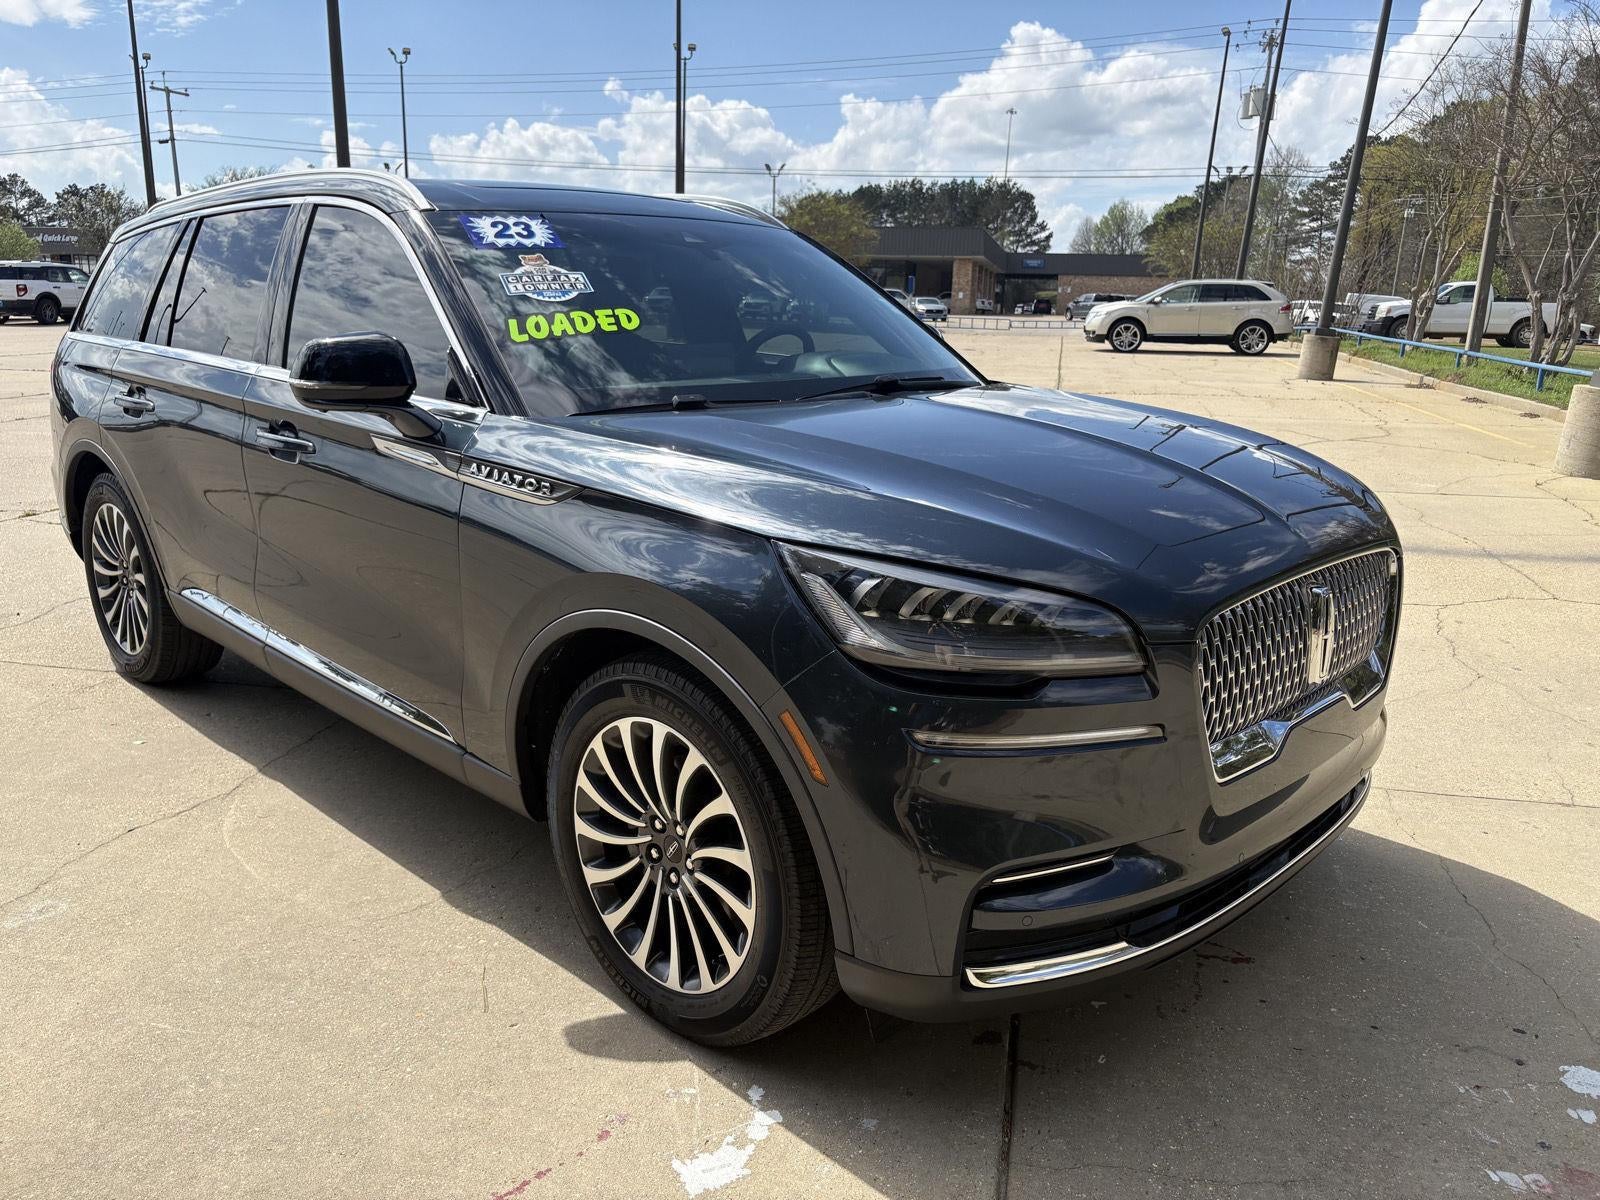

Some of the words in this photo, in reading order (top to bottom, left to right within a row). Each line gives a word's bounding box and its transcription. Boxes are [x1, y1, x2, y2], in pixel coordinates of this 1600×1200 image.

[490, 220, 535, 240] 23
[43, 234, 60, 242] Quick
[508, 275, 581, 283] CARFAX
[524, 283, 586, 291] OWNER
[507, 308, 641, 343] LOADED
[469, 462, 552, 496] AVIATOR
